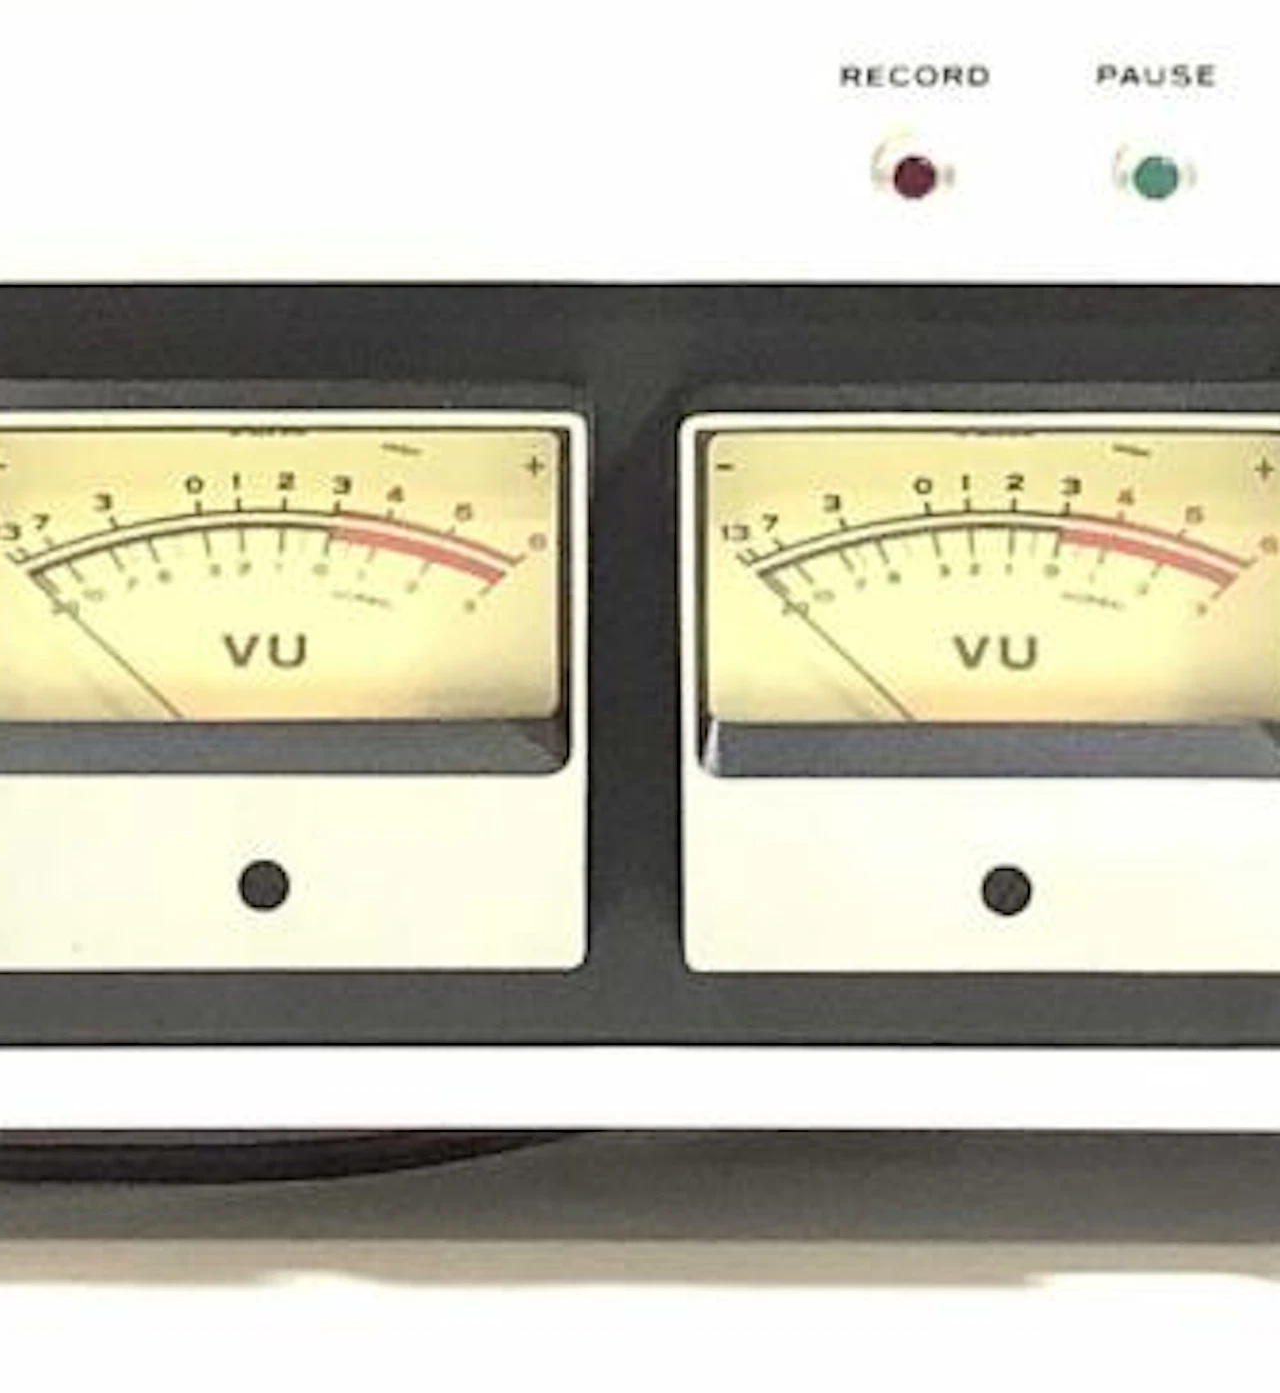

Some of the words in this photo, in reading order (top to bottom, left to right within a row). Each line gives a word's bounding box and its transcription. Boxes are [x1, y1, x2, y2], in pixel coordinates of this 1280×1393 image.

[839, 64, 991, 88] RECORD
[1096, 63, 1215, 88] PAUSE
[222, 633, 308, 670] VU
[953, 635, 1039, 672] VU
